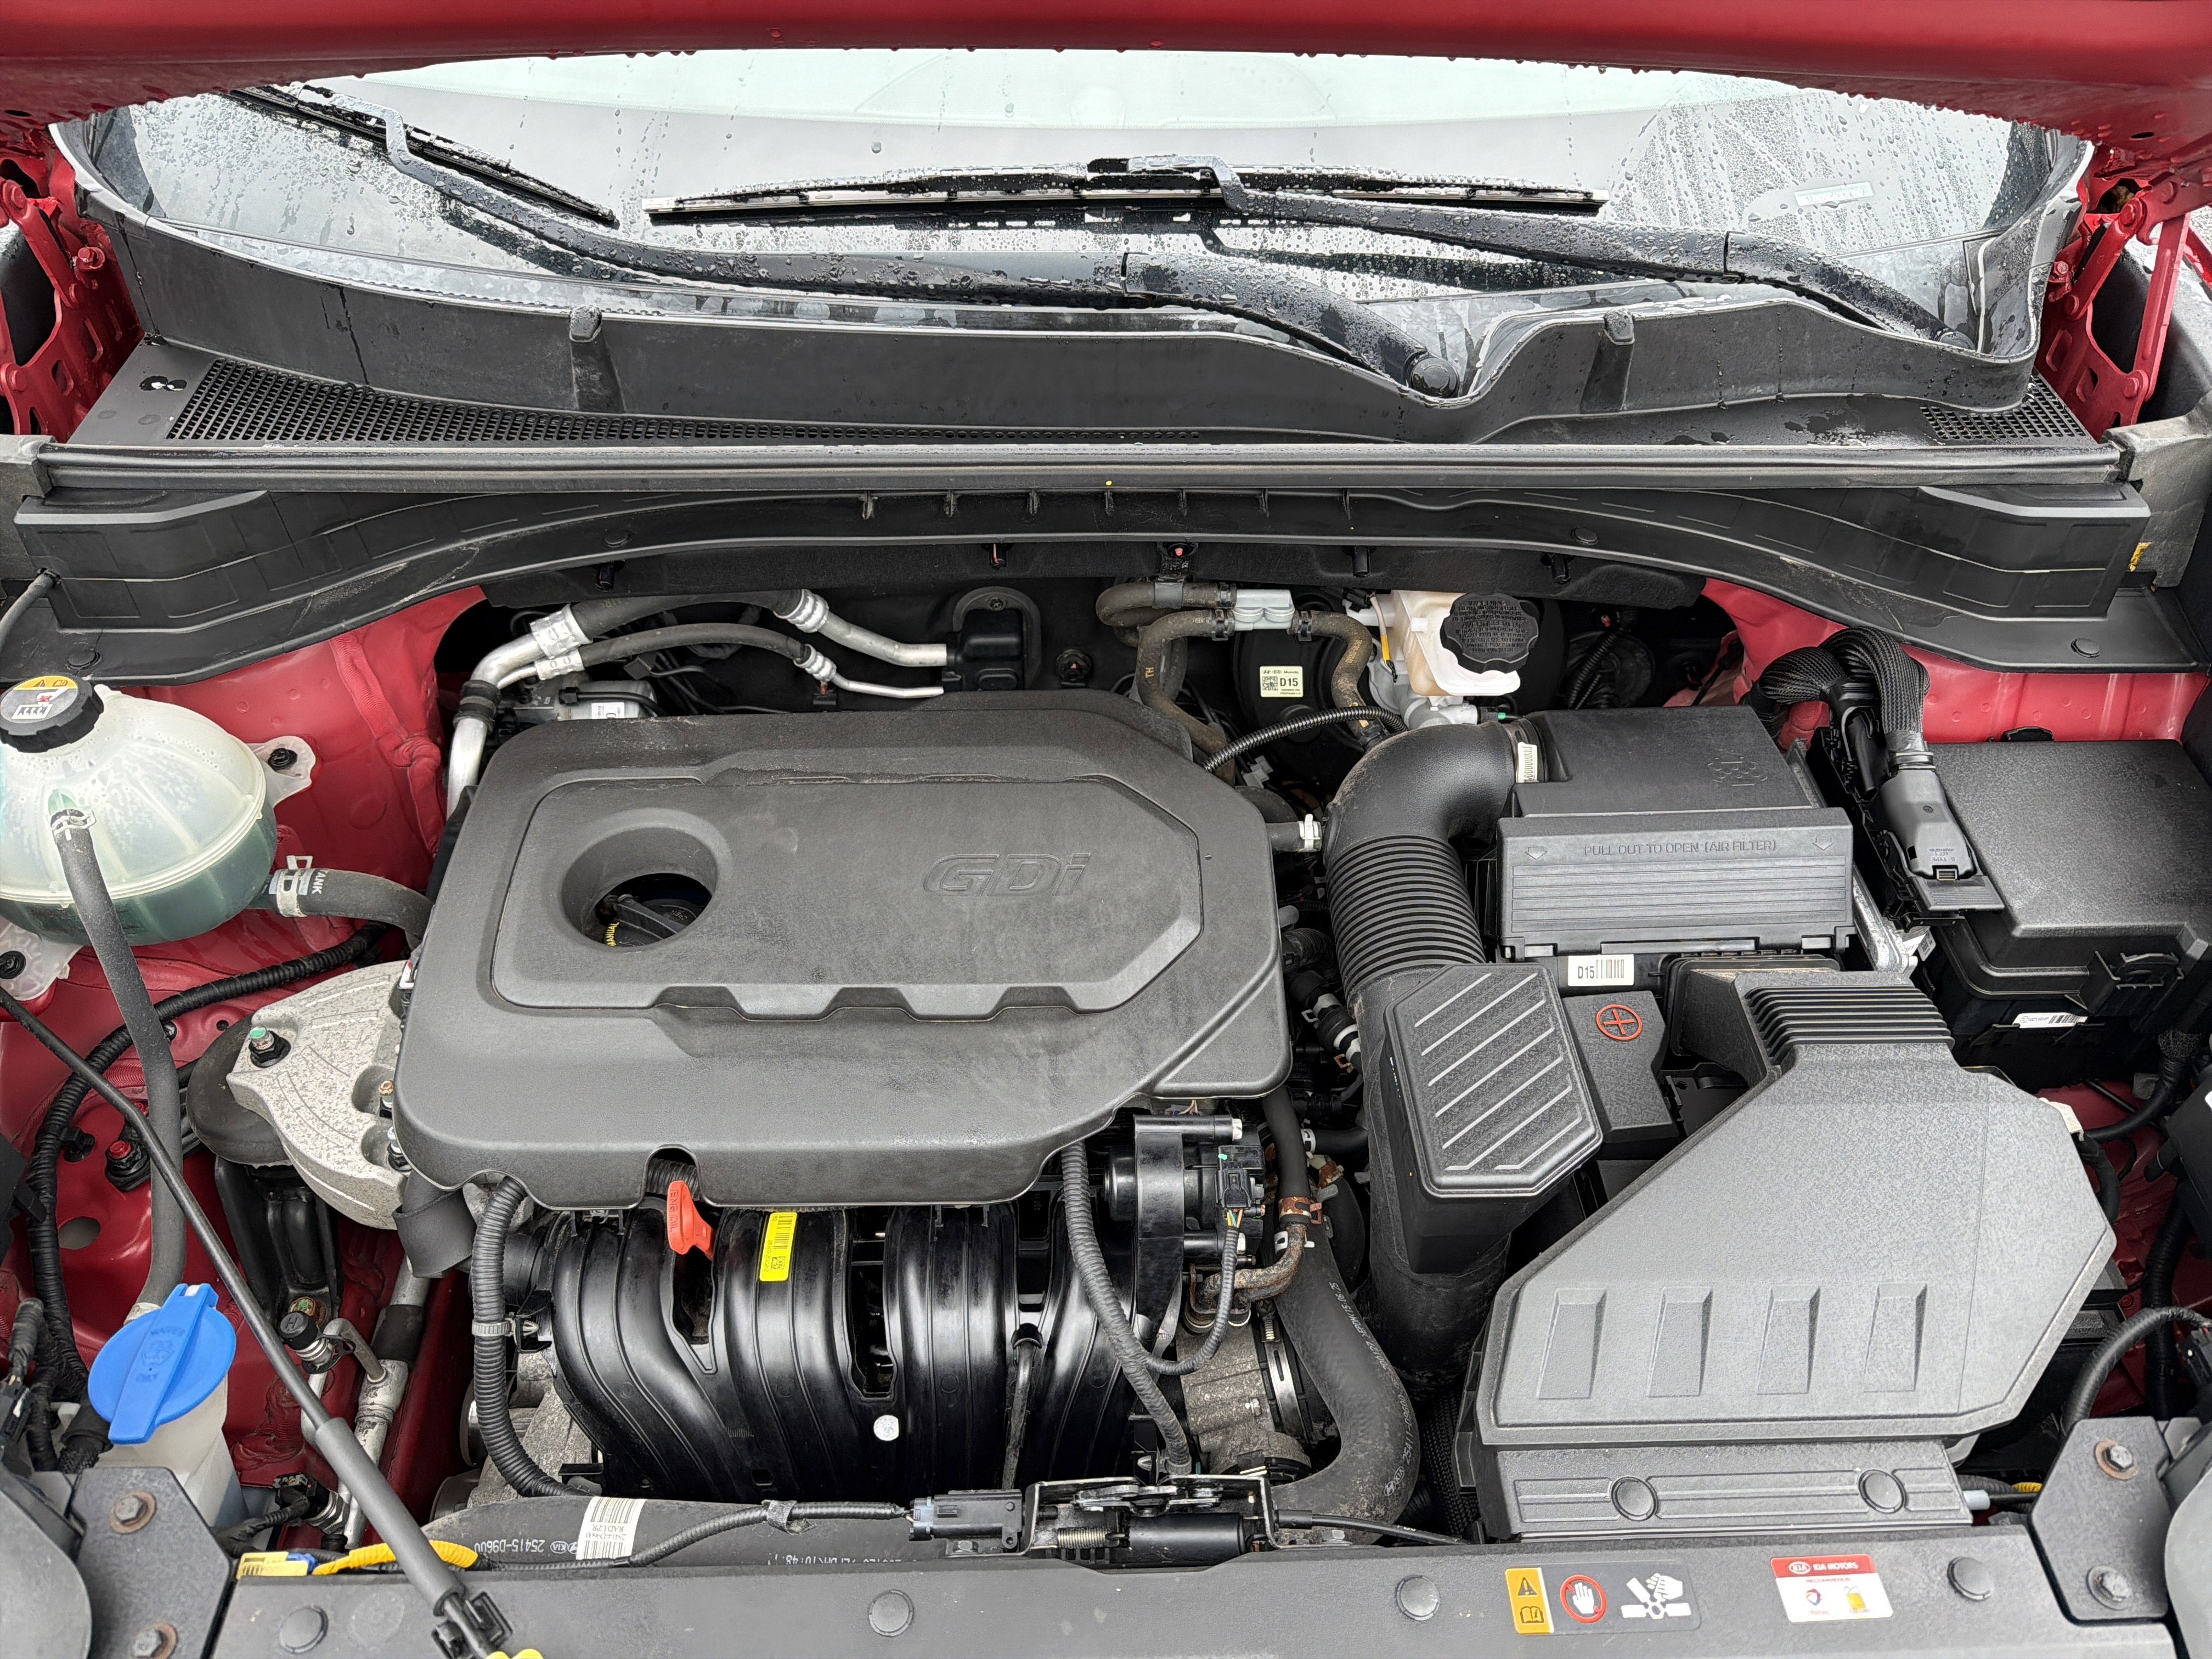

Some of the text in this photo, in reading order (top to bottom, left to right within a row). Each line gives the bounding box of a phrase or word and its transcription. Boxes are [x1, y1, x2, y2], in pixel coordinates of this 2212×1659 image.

[1280, 678, 1299, 687] D15
[1584, 839, 1778, 856] PULL OUT TO OPEN (AIR FILTER)
[312, 869, 329, 894] TANK
[923, 853, 1091, 896] GDi
[1577, 966, 1595, 979] D15
[670, 1189, 679, 1233] ENG OIL
[1813, 1562, 1827, 1571] KIA
[1827, 1562, 1859, 1570] MOTORS
